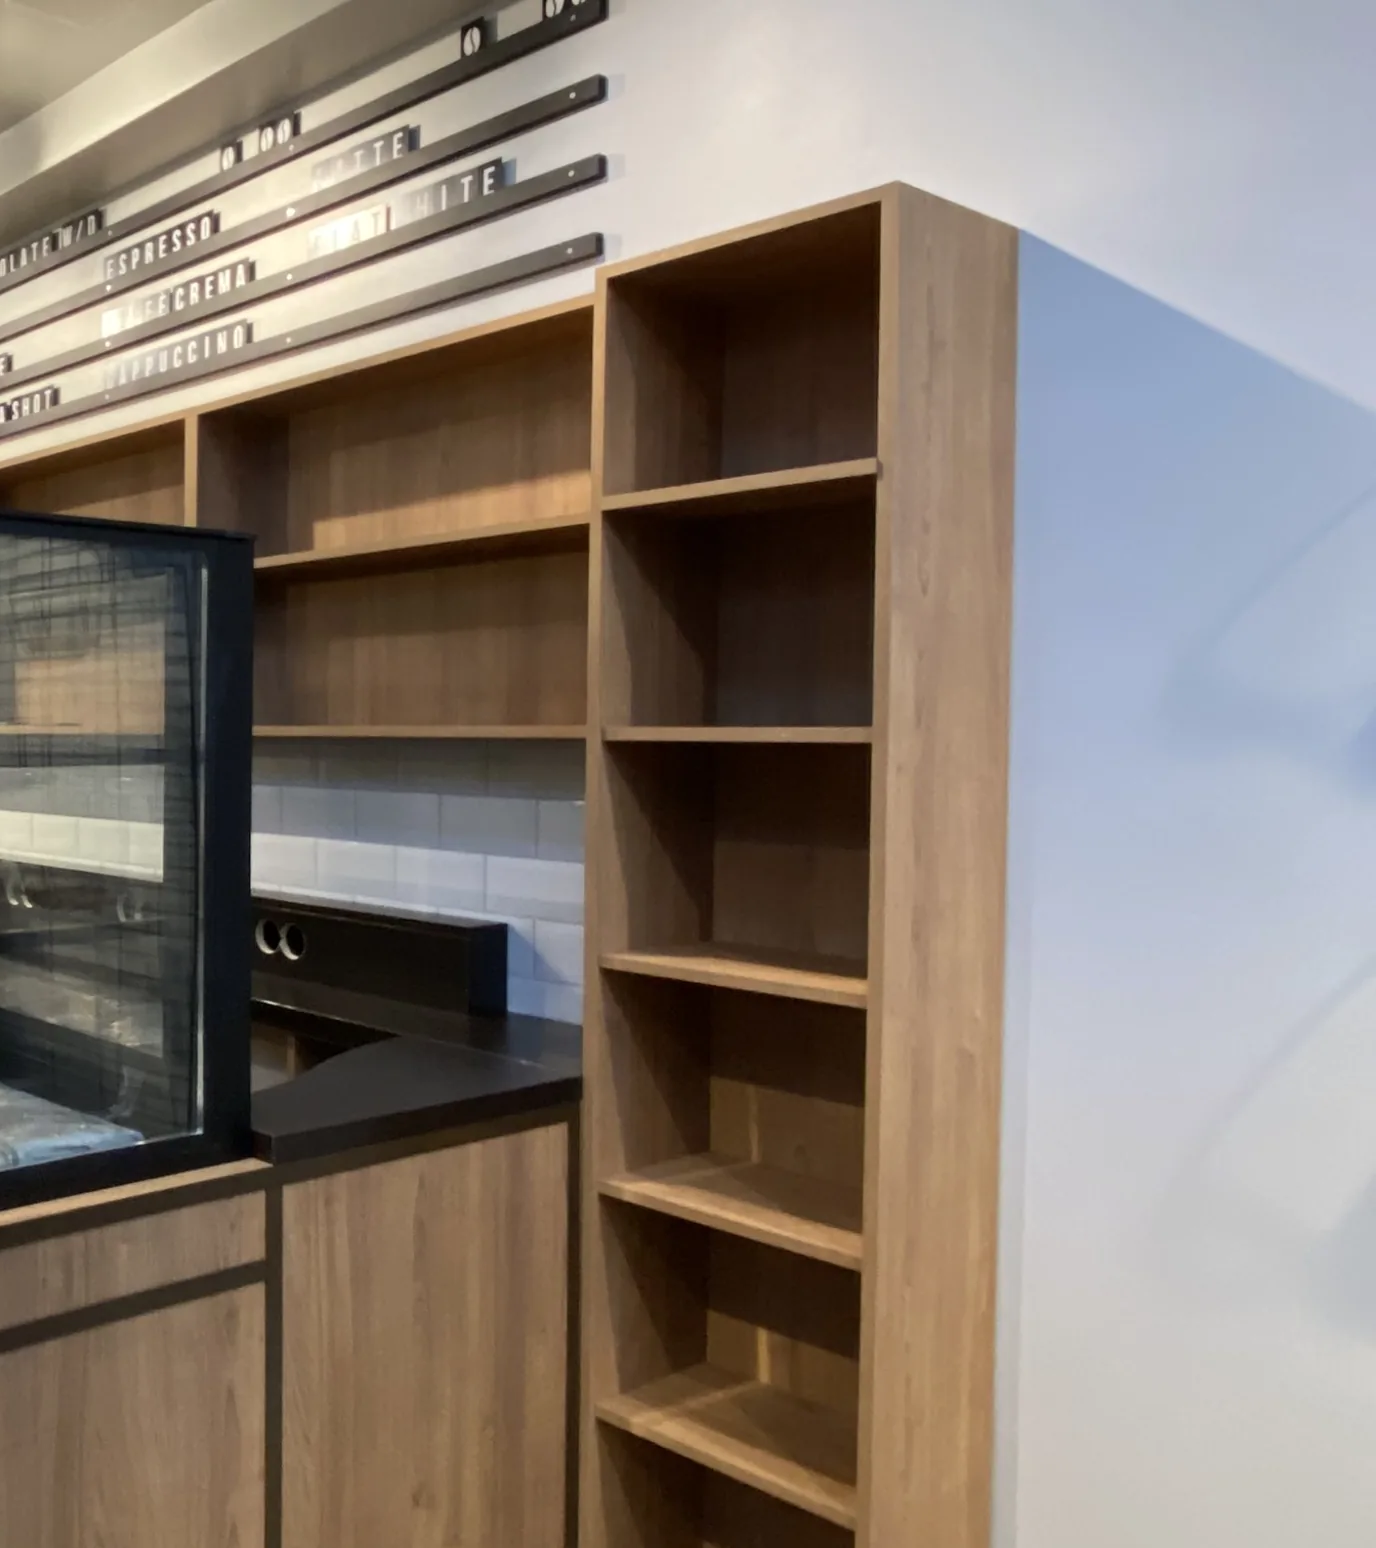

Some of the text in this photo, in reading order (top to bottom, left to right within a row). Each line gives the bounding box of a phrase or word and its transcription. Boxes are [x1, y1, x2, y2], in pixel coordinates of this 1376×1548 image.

[106, 215, 212, 278] ESPRESSO
[175, 263, 246, 311] CREMA
[11, 389, 53, 420] SHOT
